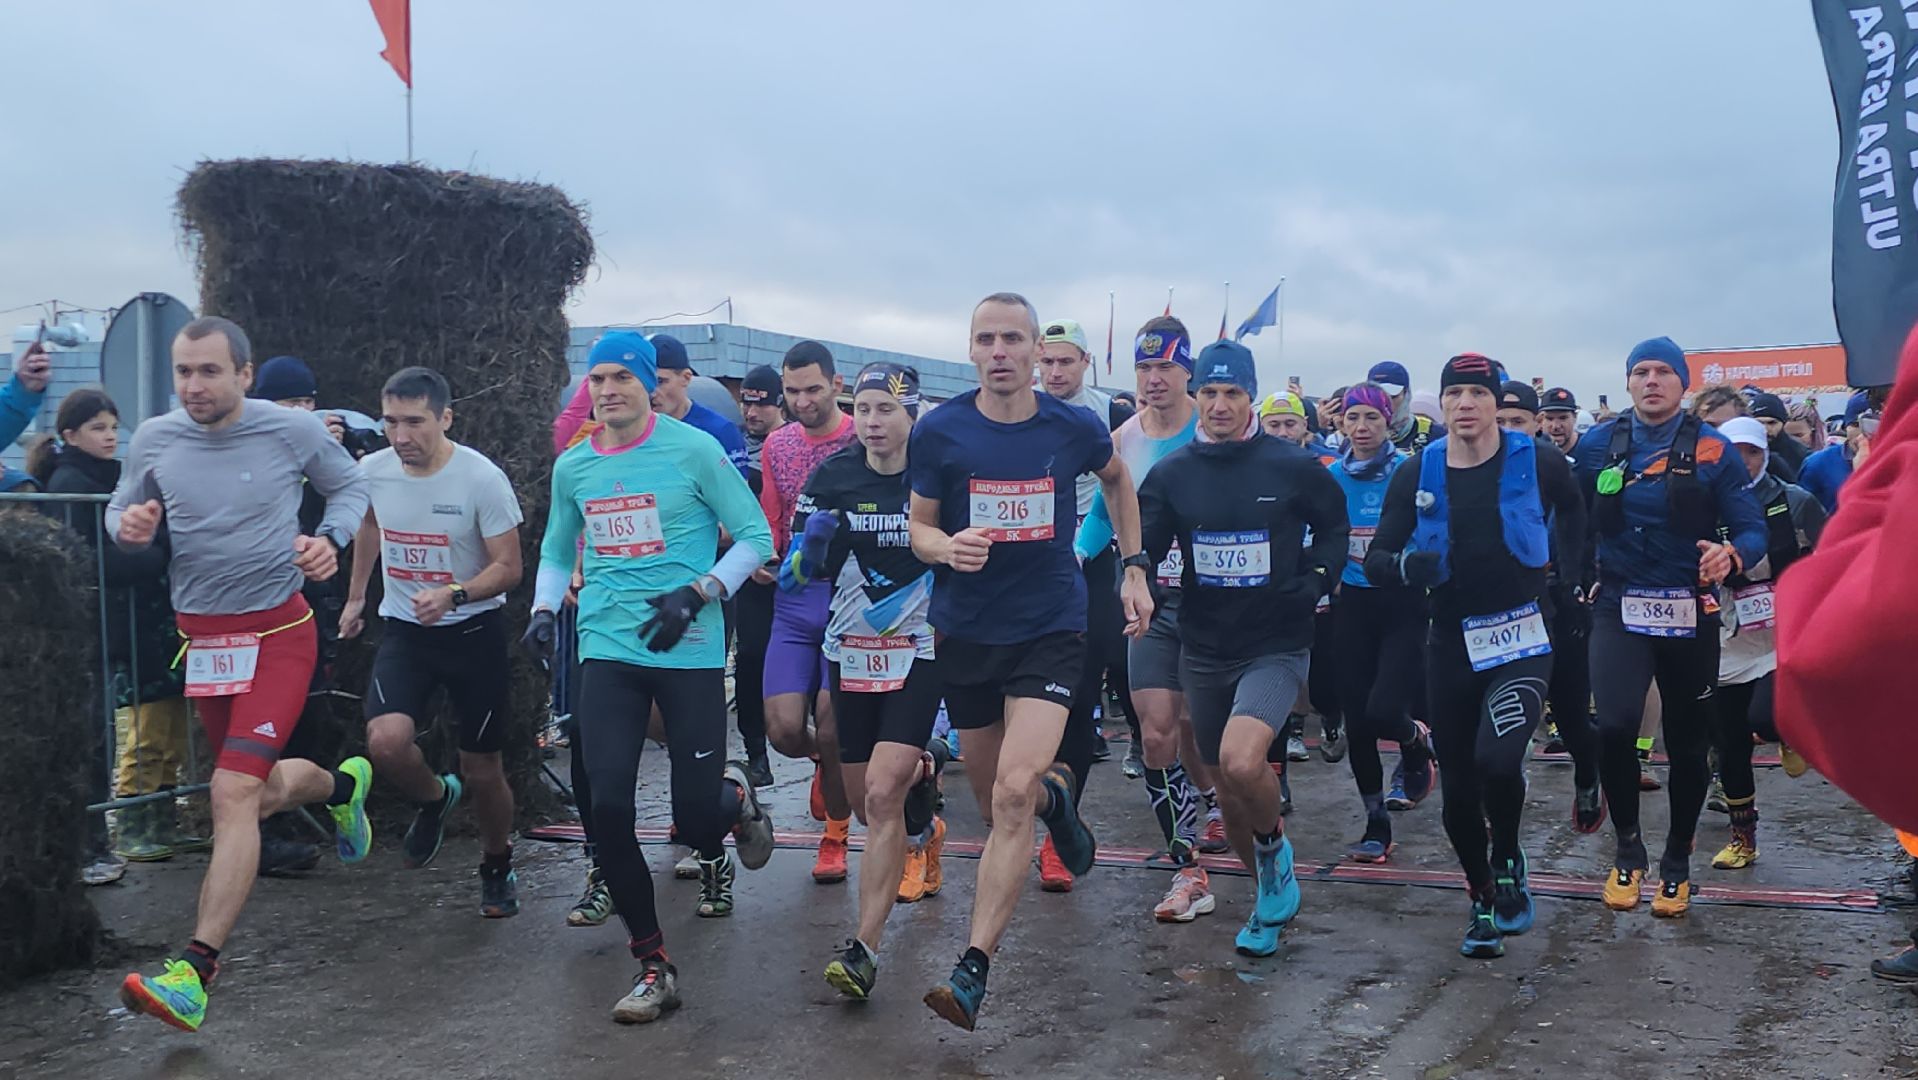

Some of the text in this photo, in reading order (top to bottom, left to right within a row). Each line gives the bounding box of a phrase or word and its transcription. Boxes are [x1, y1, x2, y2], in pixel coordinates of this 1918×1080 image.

[1726, 361, 1813, 380] НАРОДНЫЙ ТРЕЙЛ
[997, 500, 1029, 520] 216
[608, 515, 635, 538] 163
[1006, 530, 1020, 540] 5K
[403, 547, 428, 565] 157
[1214, 550, 1248, 569] 376
[1223, 577, 1241, 587] 20K
[1643, 601, 1675, 619] 384
[1488, 624, 1521, 647] 407
[212, 653, 234, 674] 161
[865, 653, 889, 673] 181
